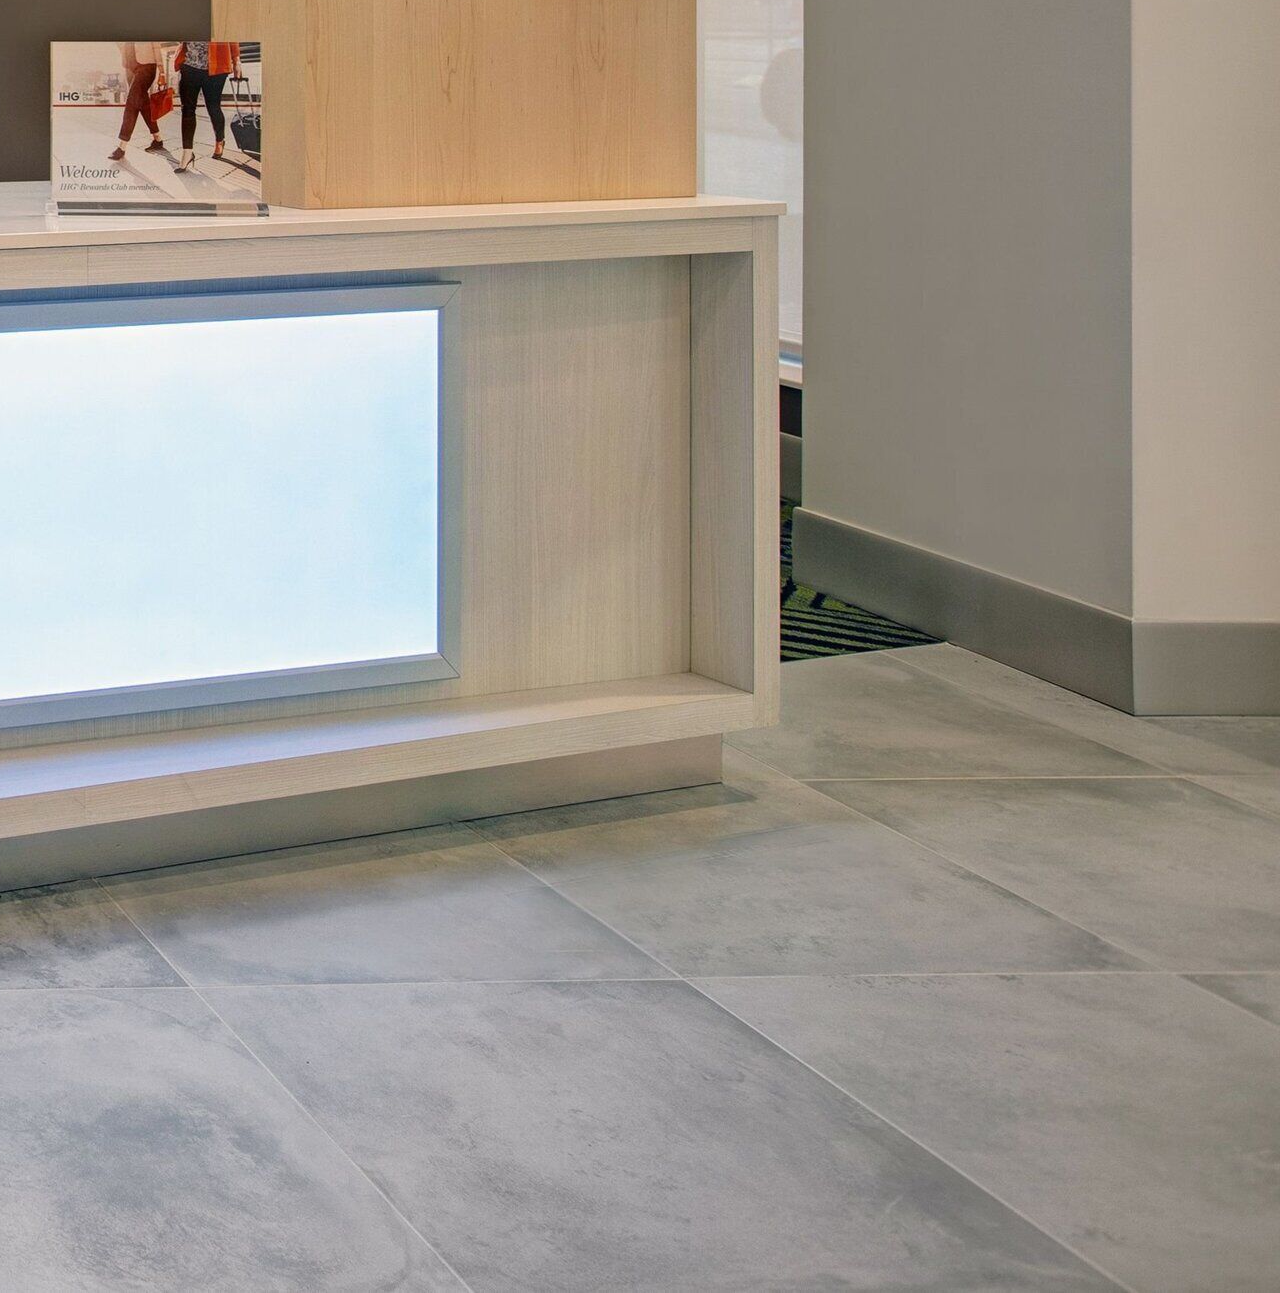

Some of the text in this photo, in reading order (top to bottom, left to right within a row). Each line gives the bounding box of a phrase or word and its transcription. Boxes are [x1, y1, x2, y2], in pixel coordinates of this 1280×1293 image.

[59, 92, 80, 101] IHG
[60, 165, 120, 179] Welcome
[79, 183, 110, 191] Rewards
[110, 183, 128, 191] Club
